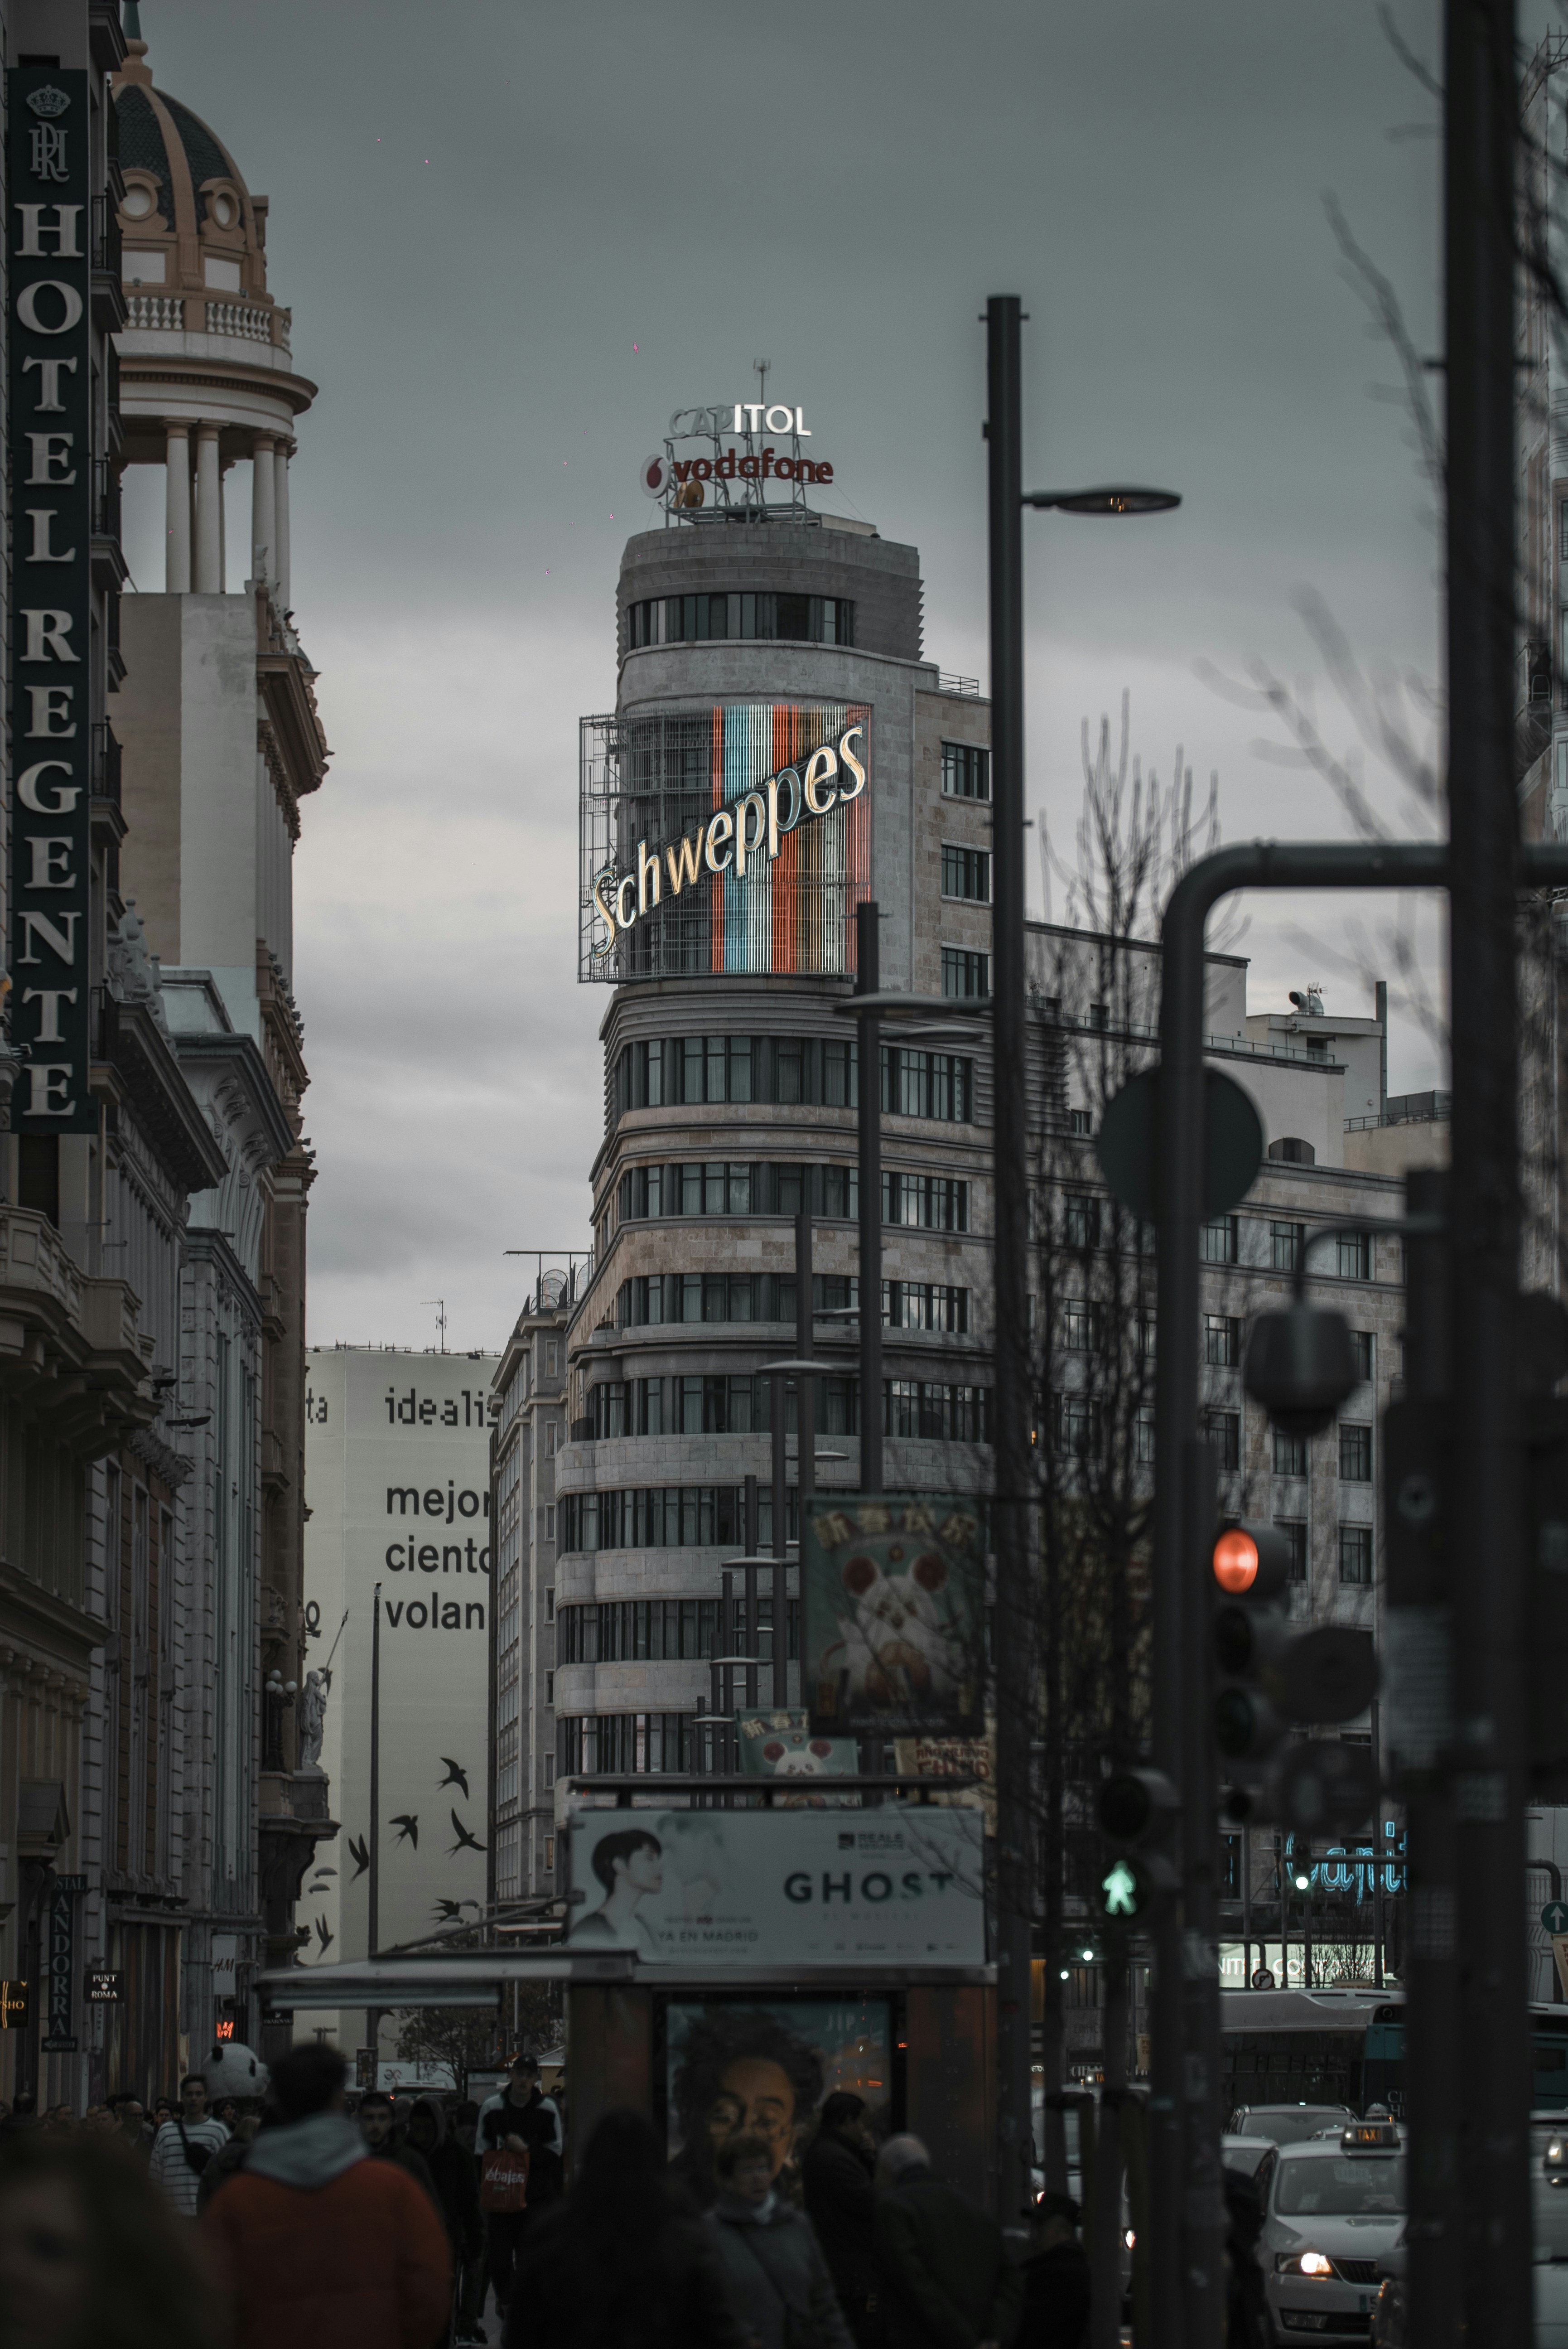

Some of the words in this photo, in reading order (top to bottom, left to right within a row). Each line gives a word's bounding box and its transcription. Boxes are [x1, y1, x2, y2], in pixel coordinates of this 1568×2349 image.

[14, 203, 85, 564] HOTEL
[669, 404, 812, 438] CAPITOL
[672, 448, 834, 484] vodafone
[592, 725, 866, 960] Schweppes
[16, 609, 83, 1117] REGENTE
[385, 1592, 485, 1629] volan
[54, 1876, 85, 1890] STAL
[784, 1872, 953, 1904] GHOST
[657, 1931, 674, 1943] YA
[680, 1932, 698, 1943] EN
[702, 1931, 758, 1943] MADRID
[51, 1895, 70, 2036] ANDORRA
[92, 1974, 117, 1982] PUNT
[91, 1990, 117, 1999] ROMA
[1356, 2128, 1381, 2141] TAXI
